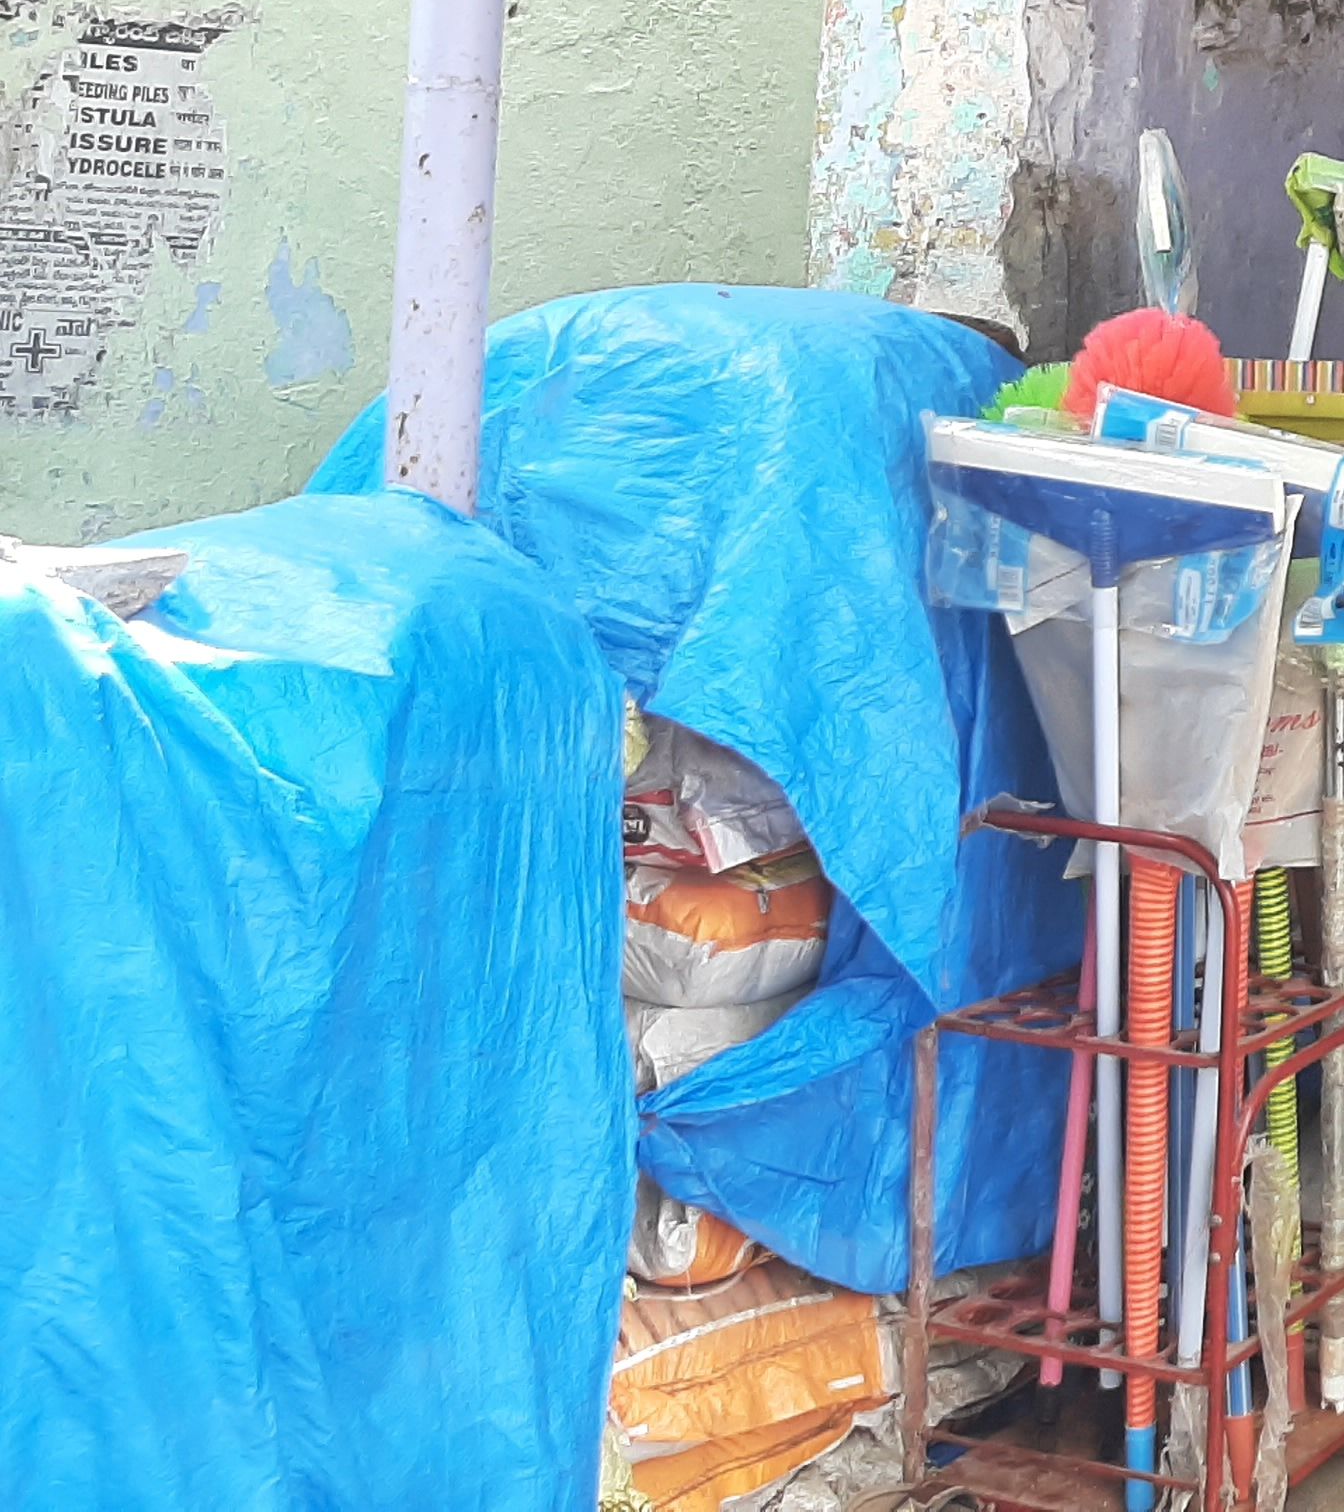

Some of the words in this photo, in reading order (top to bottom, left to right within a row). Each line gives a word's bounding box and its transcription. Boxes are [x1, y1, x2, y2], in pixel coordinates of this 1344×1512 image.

[80, 50, 139, 72] ILES
[78, 81, 128, 102] EEDING
[131, 85, 170, 104] PILES
[70, 106, 157, 129] ISTULA
[69, 132, 169, 155] ISSURE
[68, 157, 167, 180] YDROCELE
